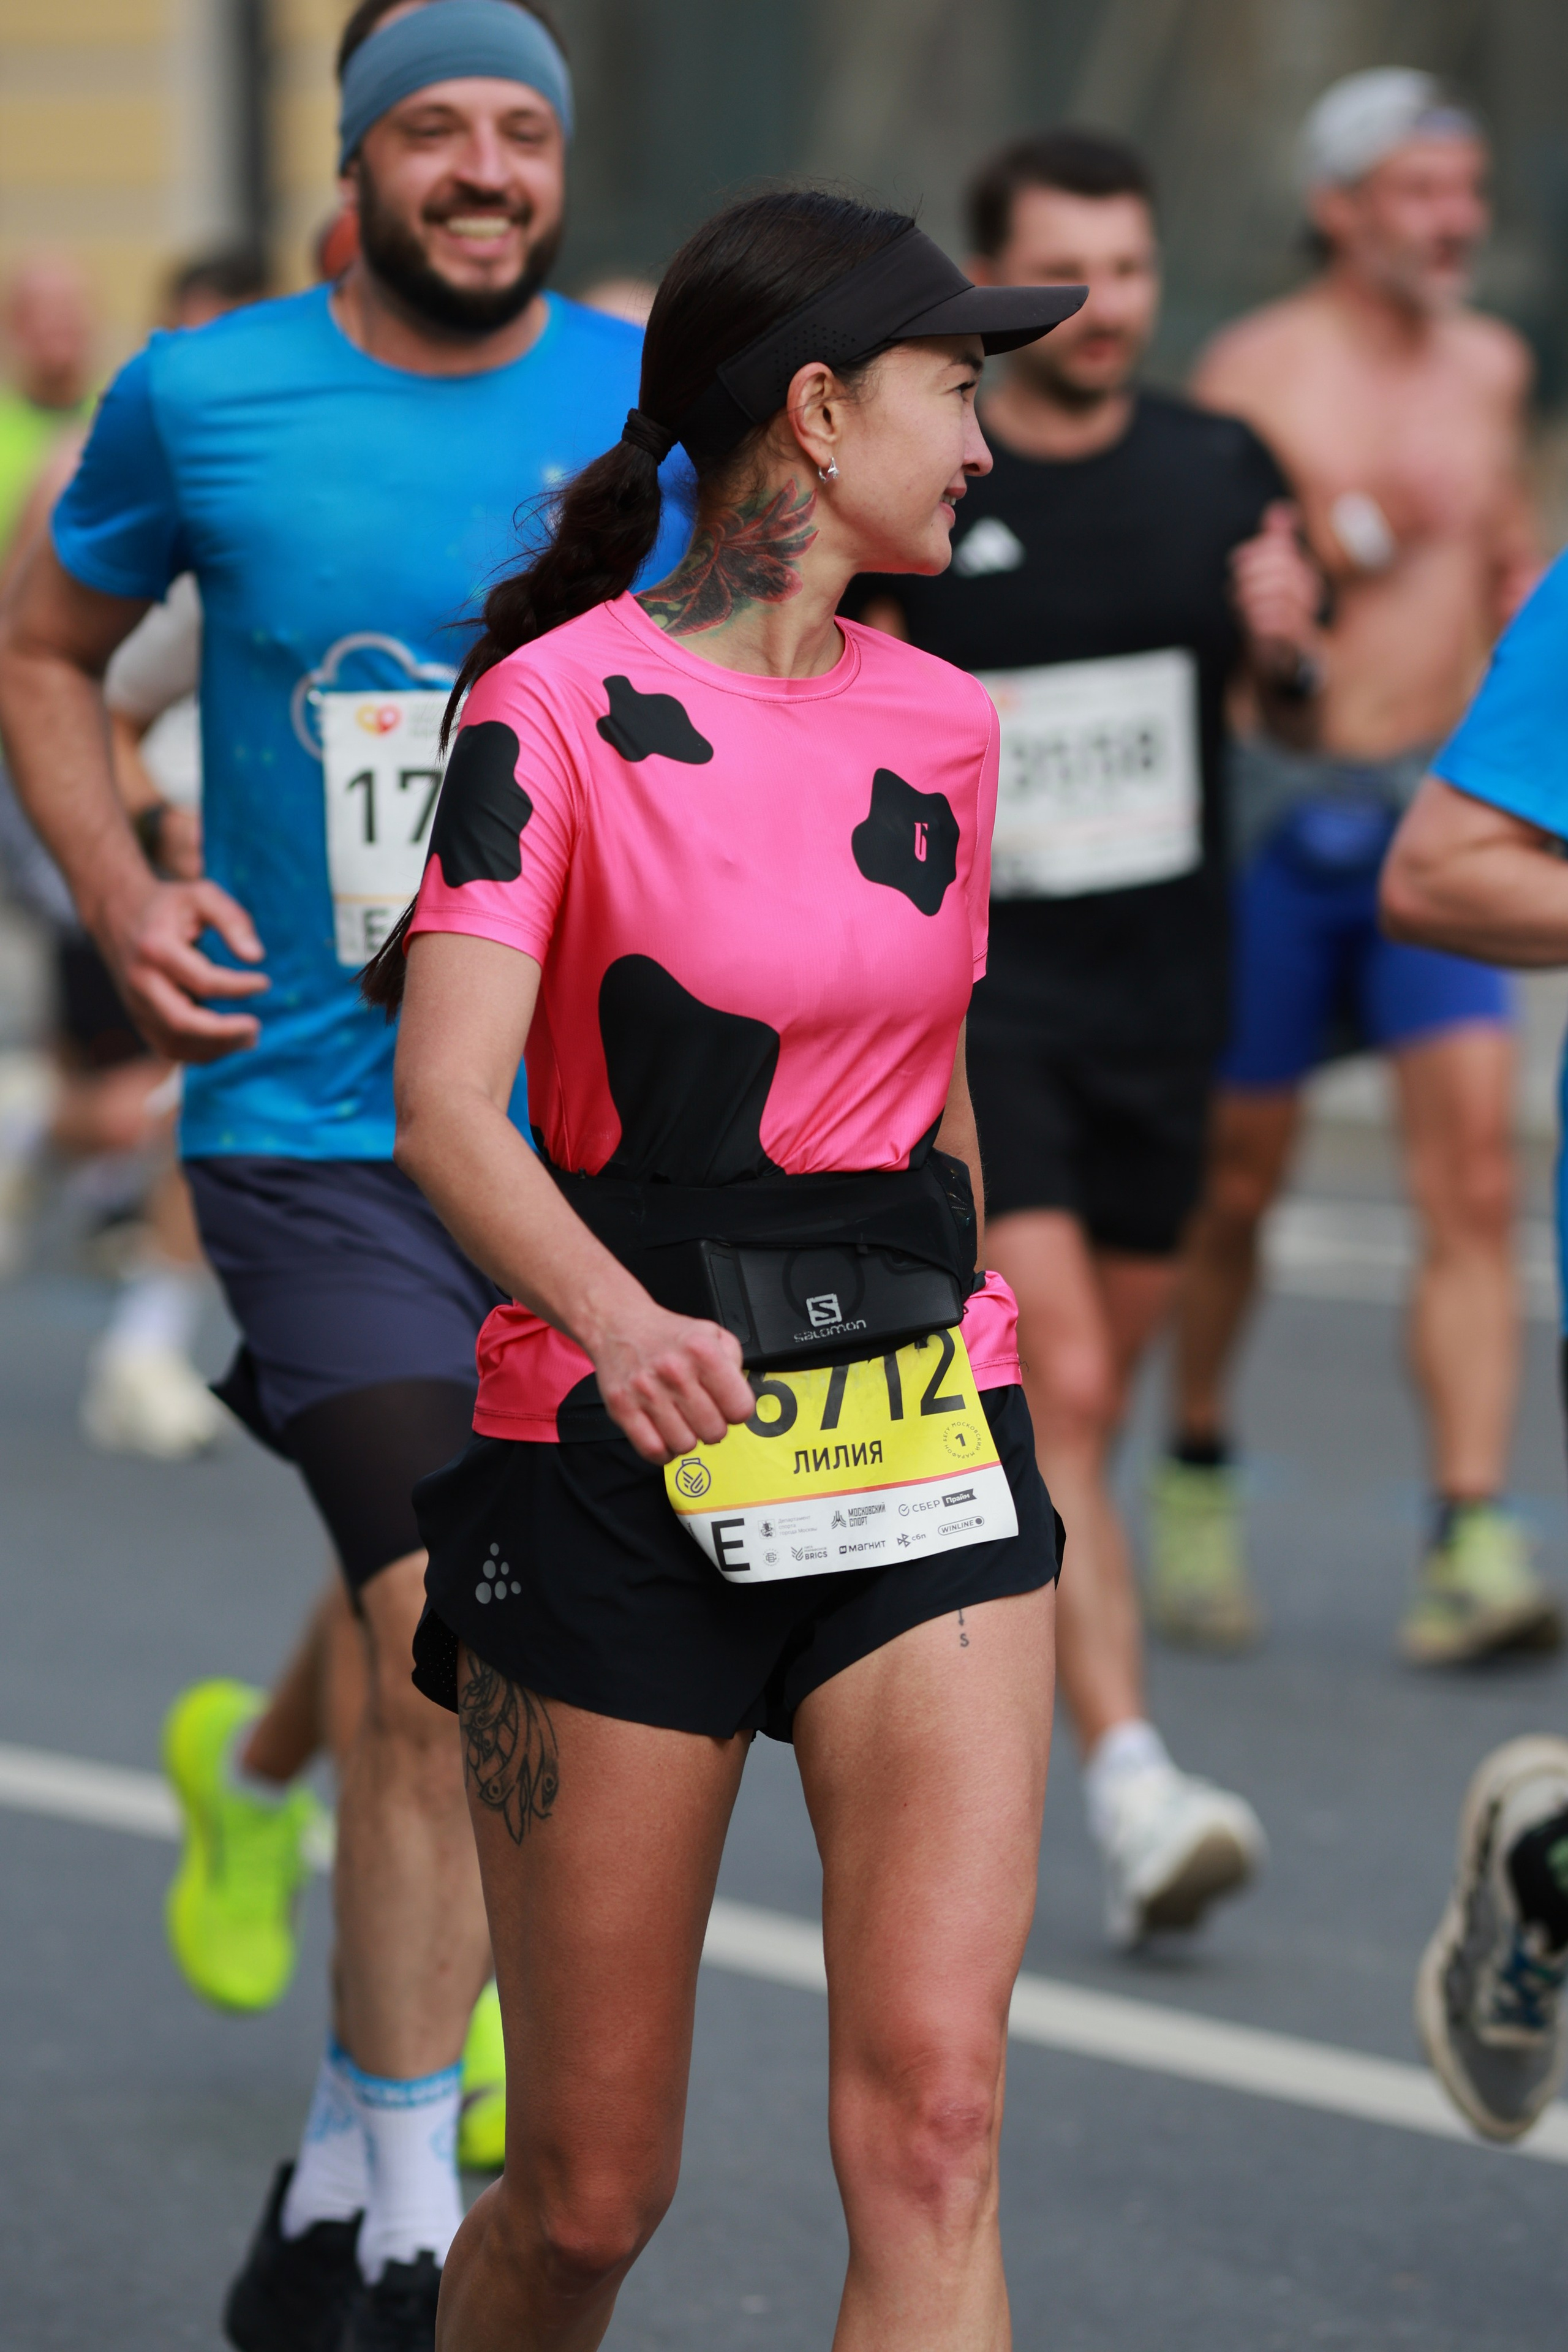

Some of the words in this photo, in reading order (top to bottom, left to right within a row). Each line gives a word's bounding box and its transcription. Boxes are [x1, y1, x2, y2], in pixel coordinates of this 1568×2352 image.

[347, 767, 443, 845] 17
[704, 1328, 965, 1444] 6712
[951, 1422, 982, 1450] МОСКОВСКИЙ
[955, 1433, 966, 1447] 1
[793, 1440, 883, 1474] ЛИЛИЯ
[944, 1444, 975, 1459] МАРАФОН
[848, 1502, 886, 1517] МОСКОВСКИЙ
[912, 1499, 940, 1512] СБЕР
[945, 1493, 970, 1504] Прайм
[849, 1517, 868, 1527] СПОРТ
[941, 1520, 974, 1534] WINLINE
[710, 1518, 751, 1572] E
[805, 1551, 827, 1560] BRICS
